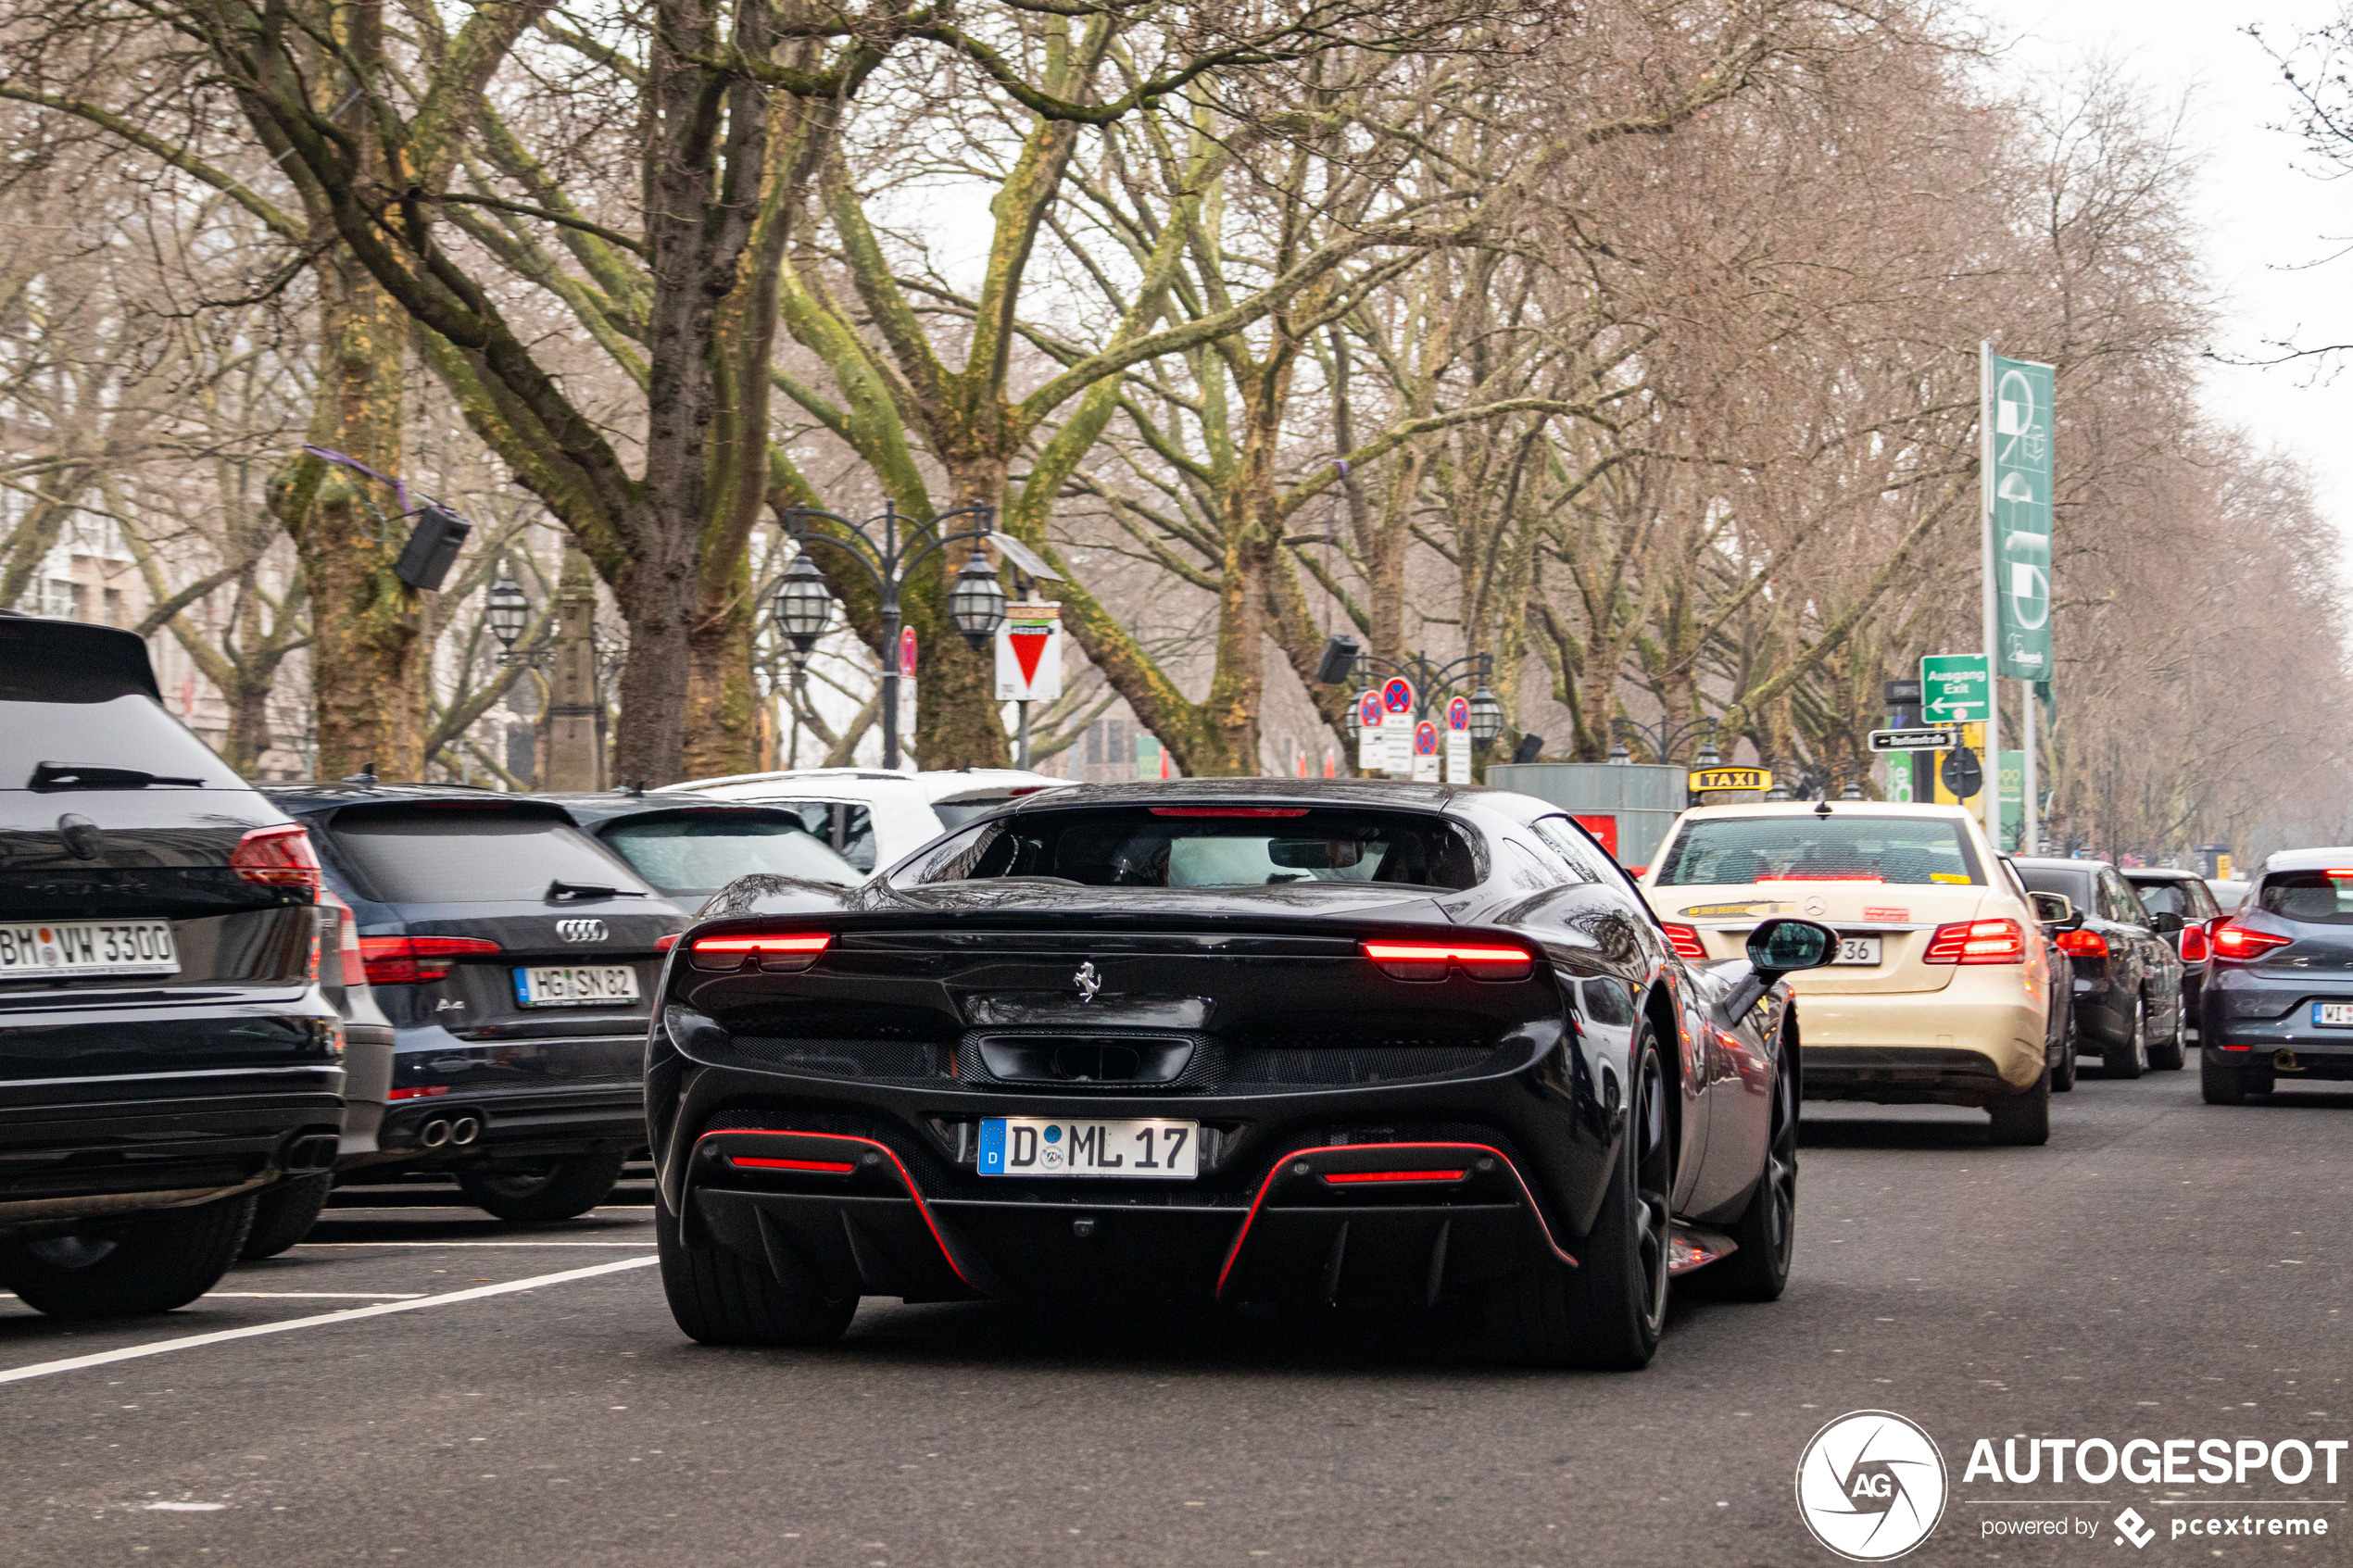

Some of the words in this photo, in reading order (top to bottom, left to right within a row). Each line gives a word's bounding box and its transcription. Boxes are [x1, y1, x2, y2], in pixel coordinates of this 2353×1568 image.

[1927, 671, 1986, 684] Ausgang
[1943, 683, 1969, 695] Exit
[1705, 772, 1755, 786] TAXI
[0, 929, 39, 965] BM
[56, 927, 96, 963] VW
[99, 925, 171, 961] 3300
[1844, 941, 1869, 960] 36
[535, 971, 562, 997] HG
[576, 969, 604, 997] SN
[606, 969, 630, 996] 82
[435, 997, 465, 1011] A4
[1011, 1125, 1038, 1167] D
[1068, 1125, 1124, 1167] ML
[1135, 1126, 1189, 1169] 17
